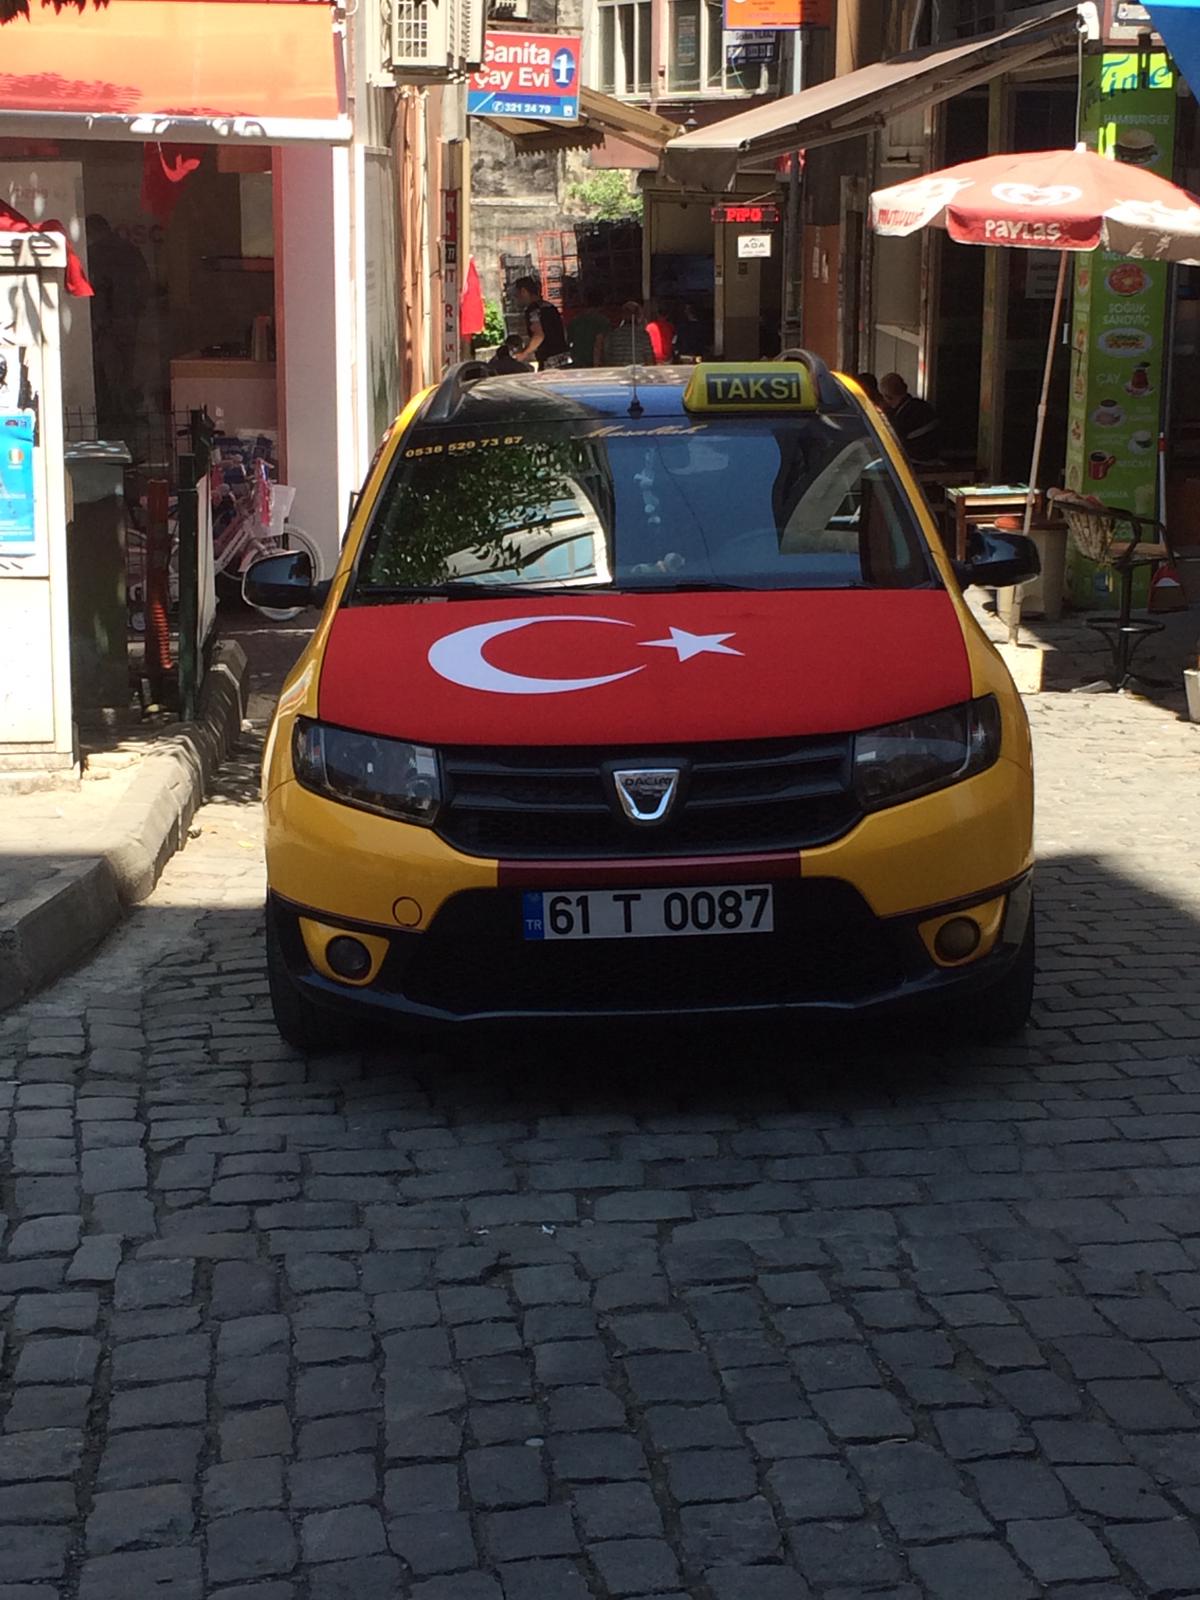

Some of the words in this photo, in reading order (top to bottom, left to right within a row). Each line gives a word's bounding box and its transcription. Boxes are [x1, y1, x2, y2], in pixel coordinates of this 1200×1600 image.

[484, 40, 551, 65] Ganita
[473, 63, 513, 90] Çay
[518, 66, 550, 87] Evi
[555, 54, 570, 83] 1
[524, 103, 538, 113] 24
[525, 918, 542, 931] TR
[549, 894, 590, 935] 61
[612, 893, 642, 933] T
[662, 888, 770, 931] 0087
